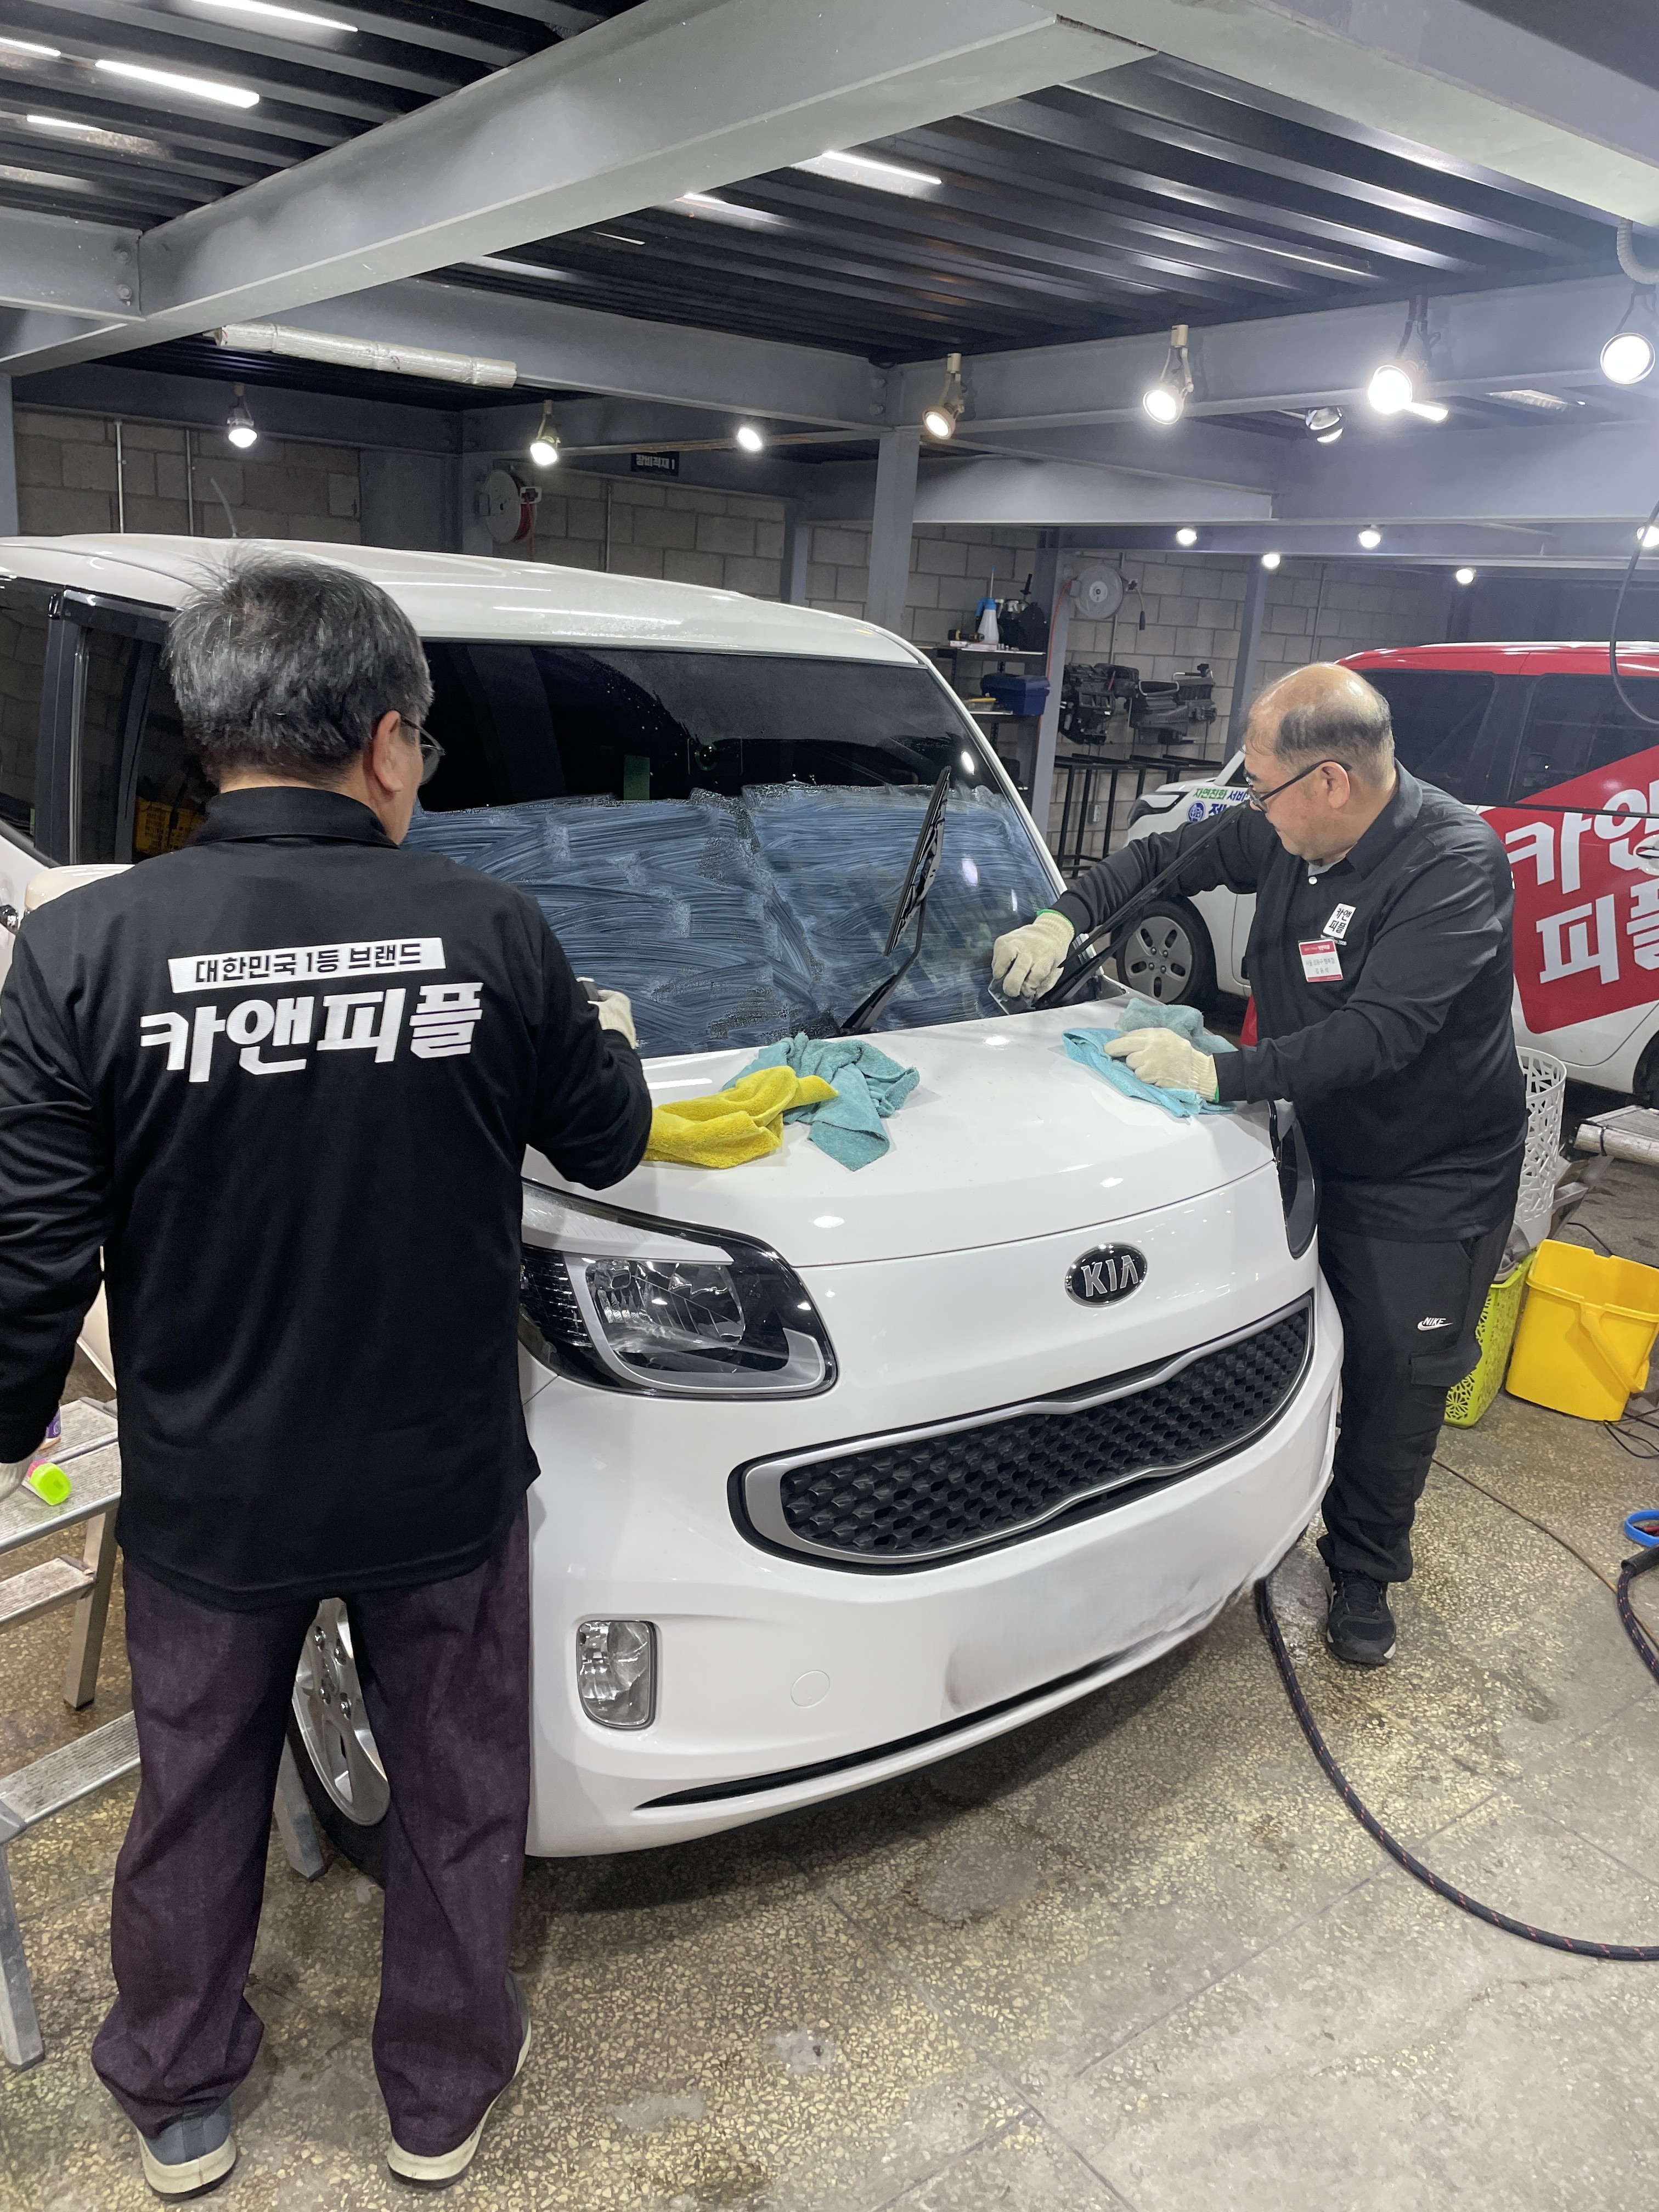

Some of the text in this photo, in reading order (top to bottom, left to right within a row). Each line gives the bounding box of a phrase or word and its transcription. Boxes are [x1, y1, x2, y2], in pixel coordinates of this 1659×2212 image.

[1193, 788, 1246, 802] 자연친화 서비
[1336, 908, 1352, 921] 카앤
[1329, 920, 1346, 934] 피플
[195, 943, 421, 983] 대한민국 1등 브랜드
[140, 983, 483, 1082] 카앤피플
[1081, 1255, 1139, 1297] KIA
[1423, 1317, 1446, 1326] NIKE
